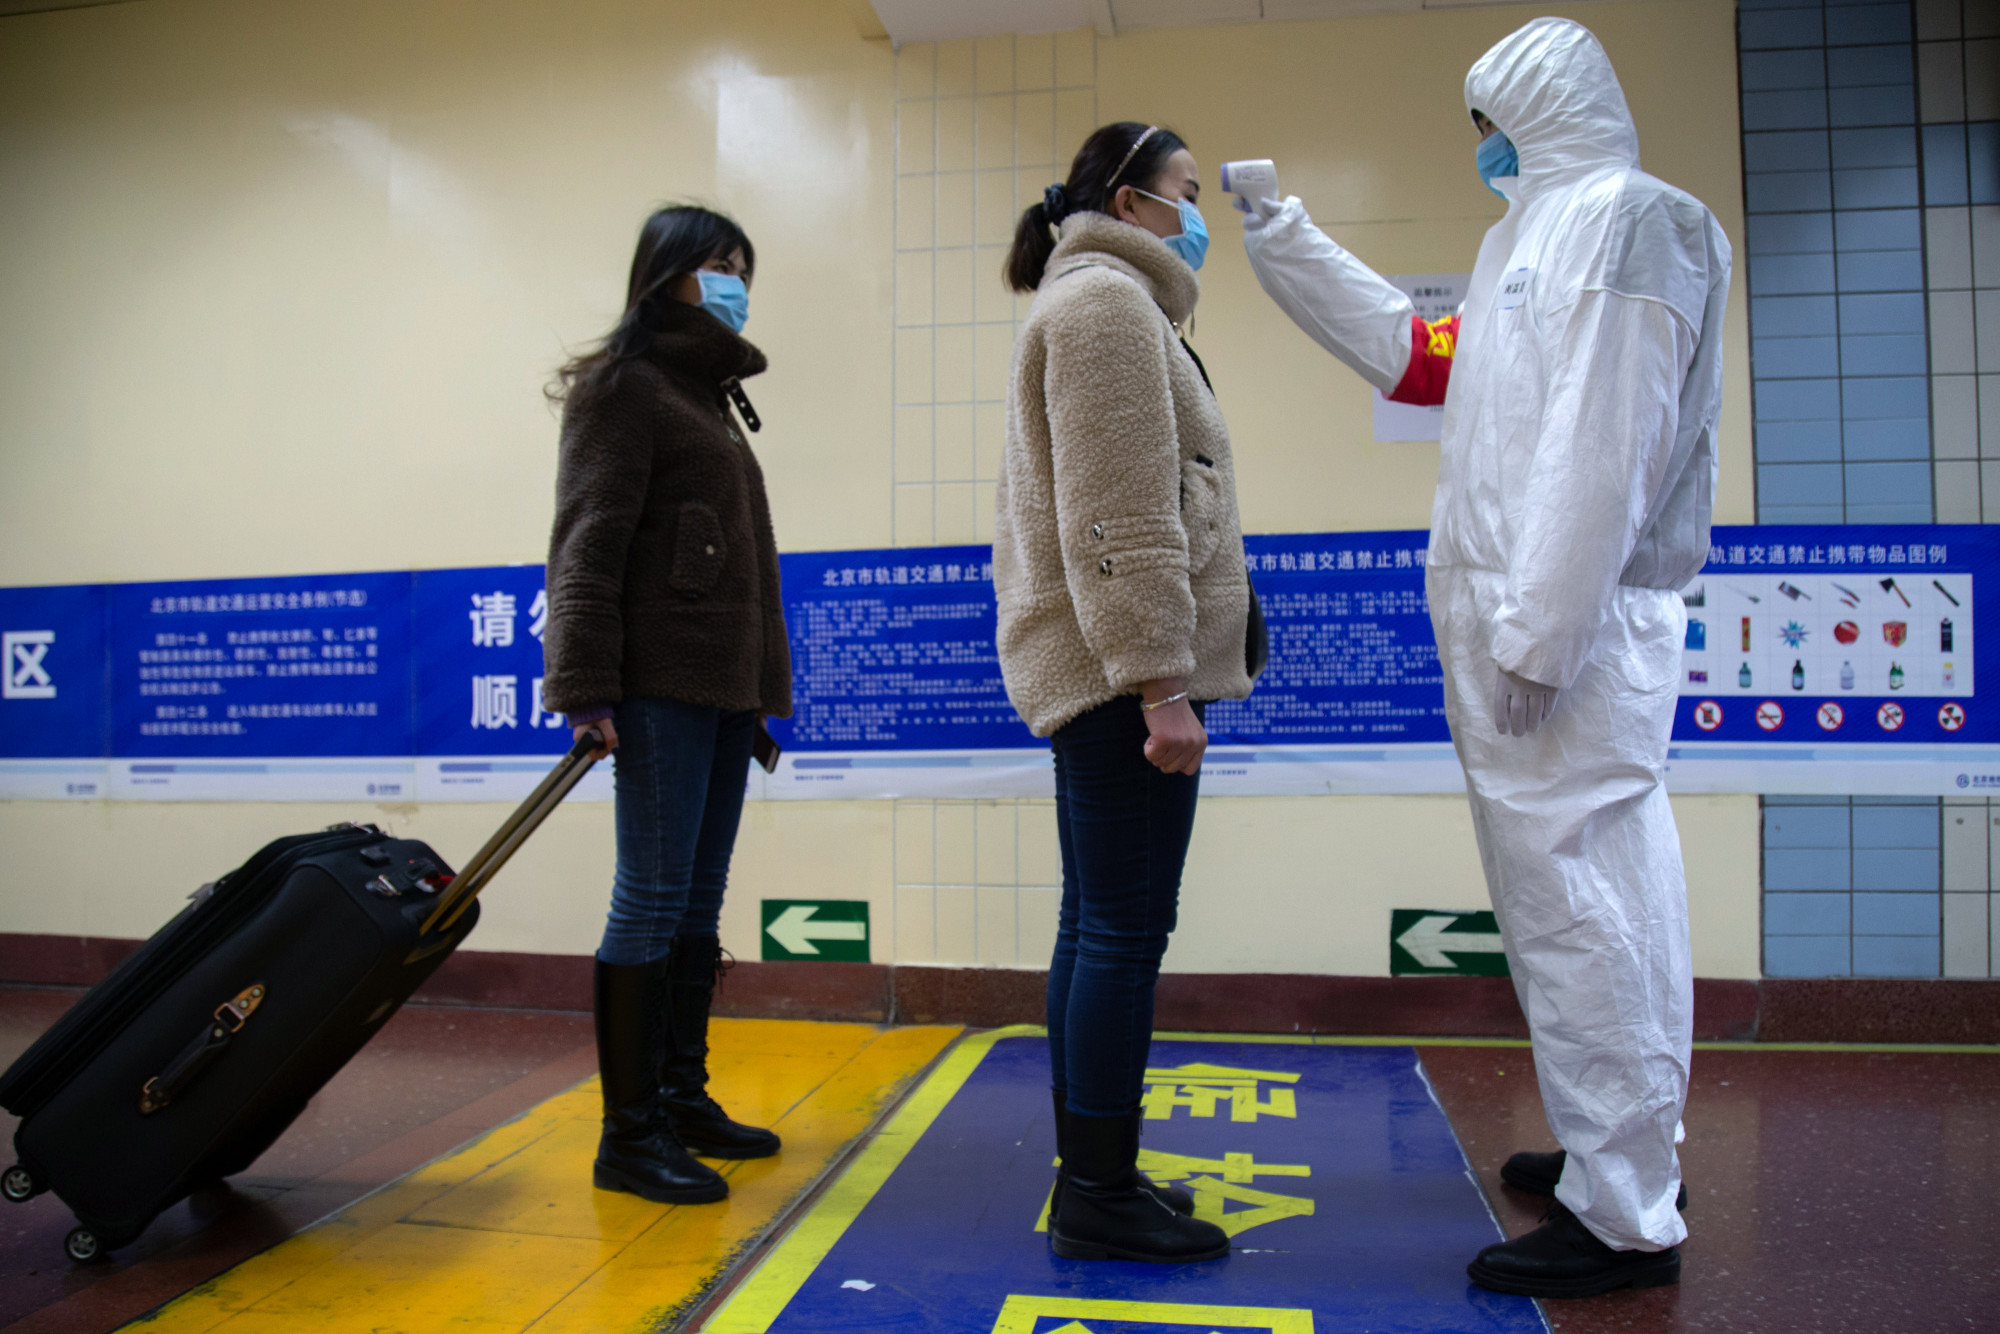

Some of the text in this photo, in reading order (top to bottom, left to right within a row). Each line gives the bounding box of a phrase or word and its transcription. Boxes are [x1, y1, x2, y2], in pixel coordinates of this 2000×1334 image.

[1709, 544, 1947, 565] 轨道交通禁止携带物品图例
[1, 630, 57, 699] 区
